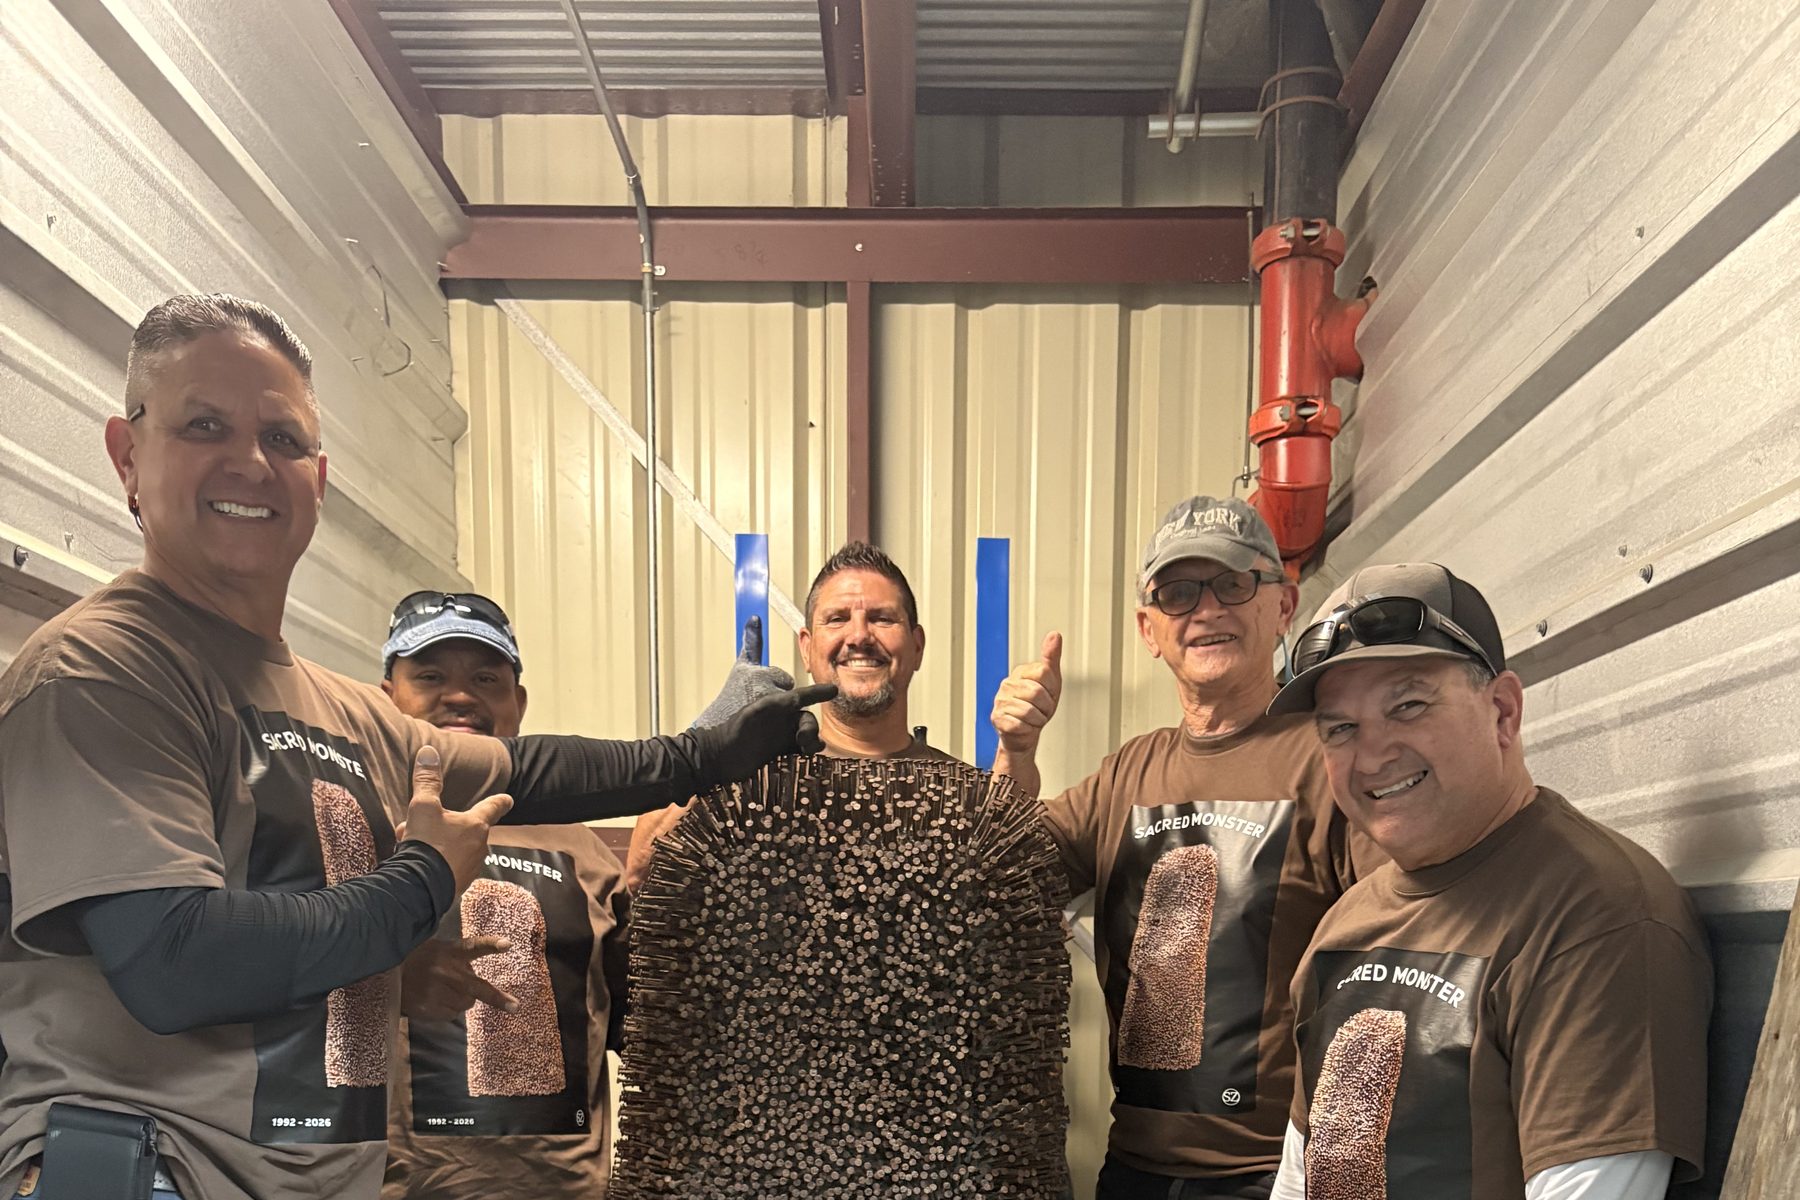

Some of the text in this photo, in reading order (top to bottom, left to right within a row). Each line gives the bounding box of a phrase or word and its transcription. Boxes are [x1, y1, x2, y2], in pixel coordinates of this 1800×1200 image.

[1193, 507, 1242, 537] YORK
[307, 736, 367, 781] MONSTE
[1134, 812, 1265, 839] SACRED MONSTER
[484, 853, 563, 883] MONSTER
[272, 1117, 296, 1127] 1992
[305, 1117, 332, 1127] 2026
[427, 1118, 447, 1126] 1992
[453, 1118, 475, 1126] 2026
